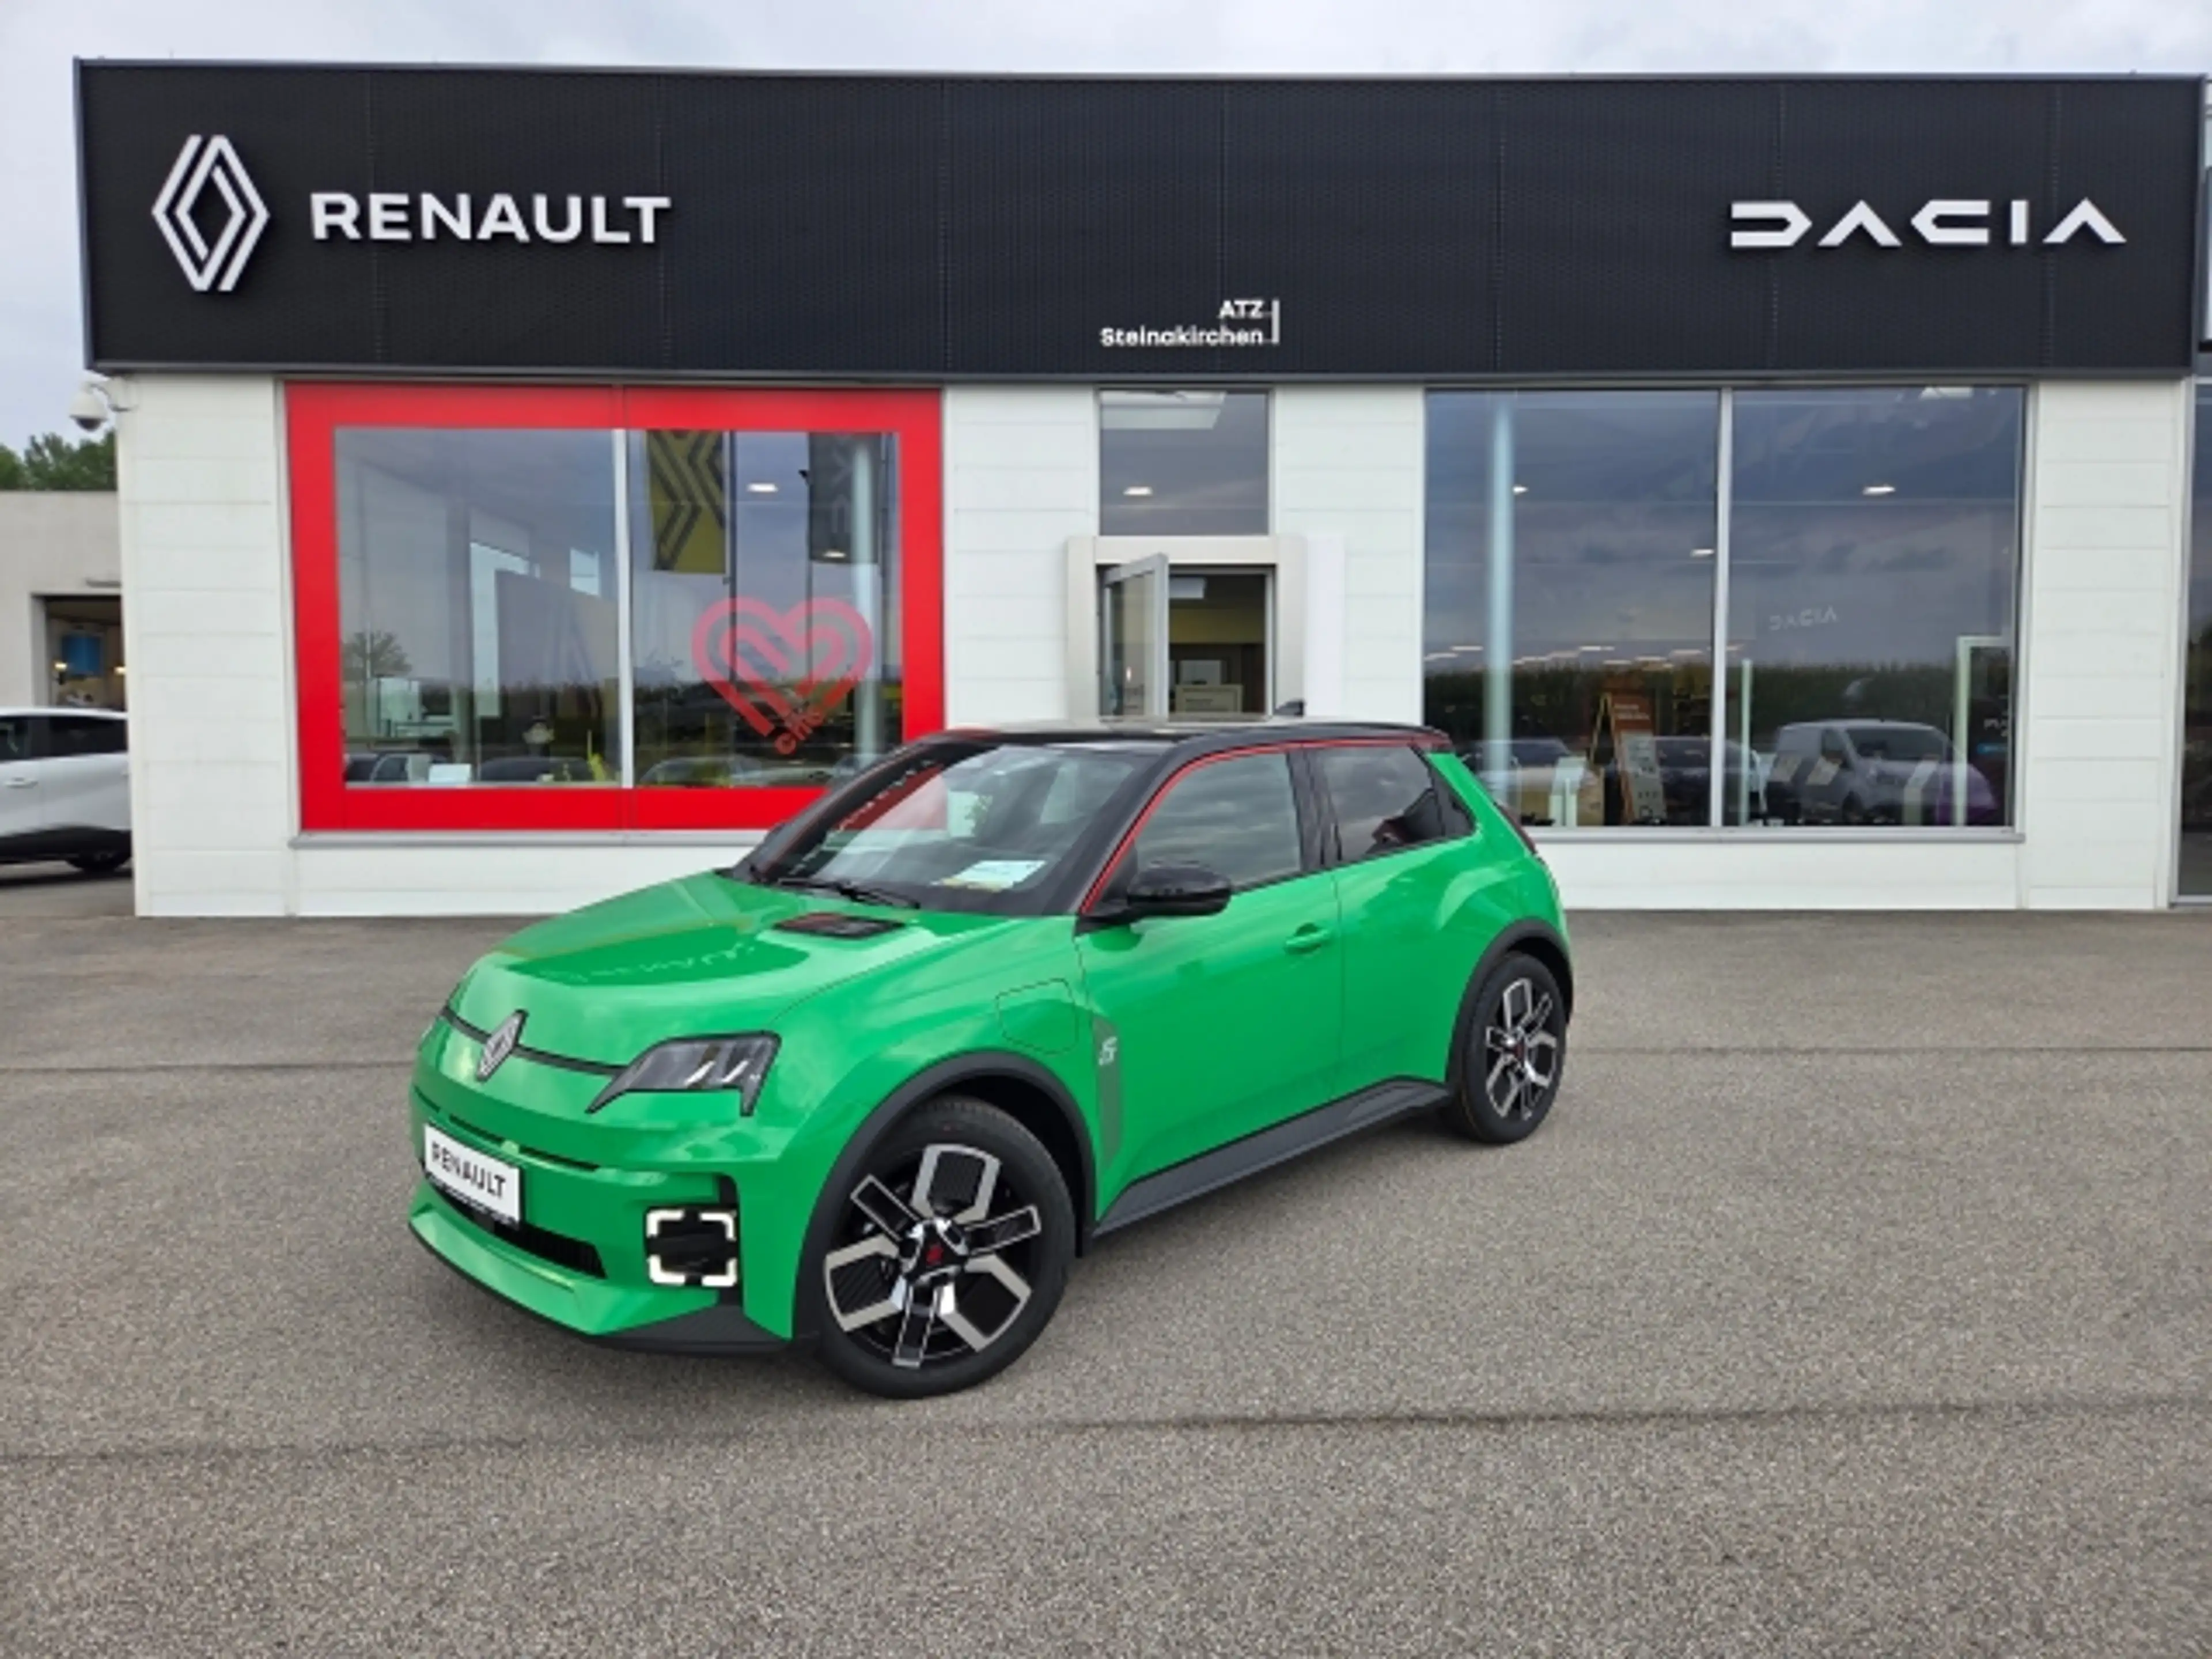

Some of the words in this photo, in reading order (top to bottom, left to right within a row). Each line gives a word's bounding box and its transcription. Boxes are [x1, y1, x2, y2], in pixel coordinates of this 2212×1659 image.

[310, 192, 672, 243] RENAULT
[1730, 198, 2127, 248] DACIA
[1218, 299, 1264, 318] ATZ
[1100, 325, 1264, 346] Steinakirchen
[432, 1141, 506, 1199] RENAULT
